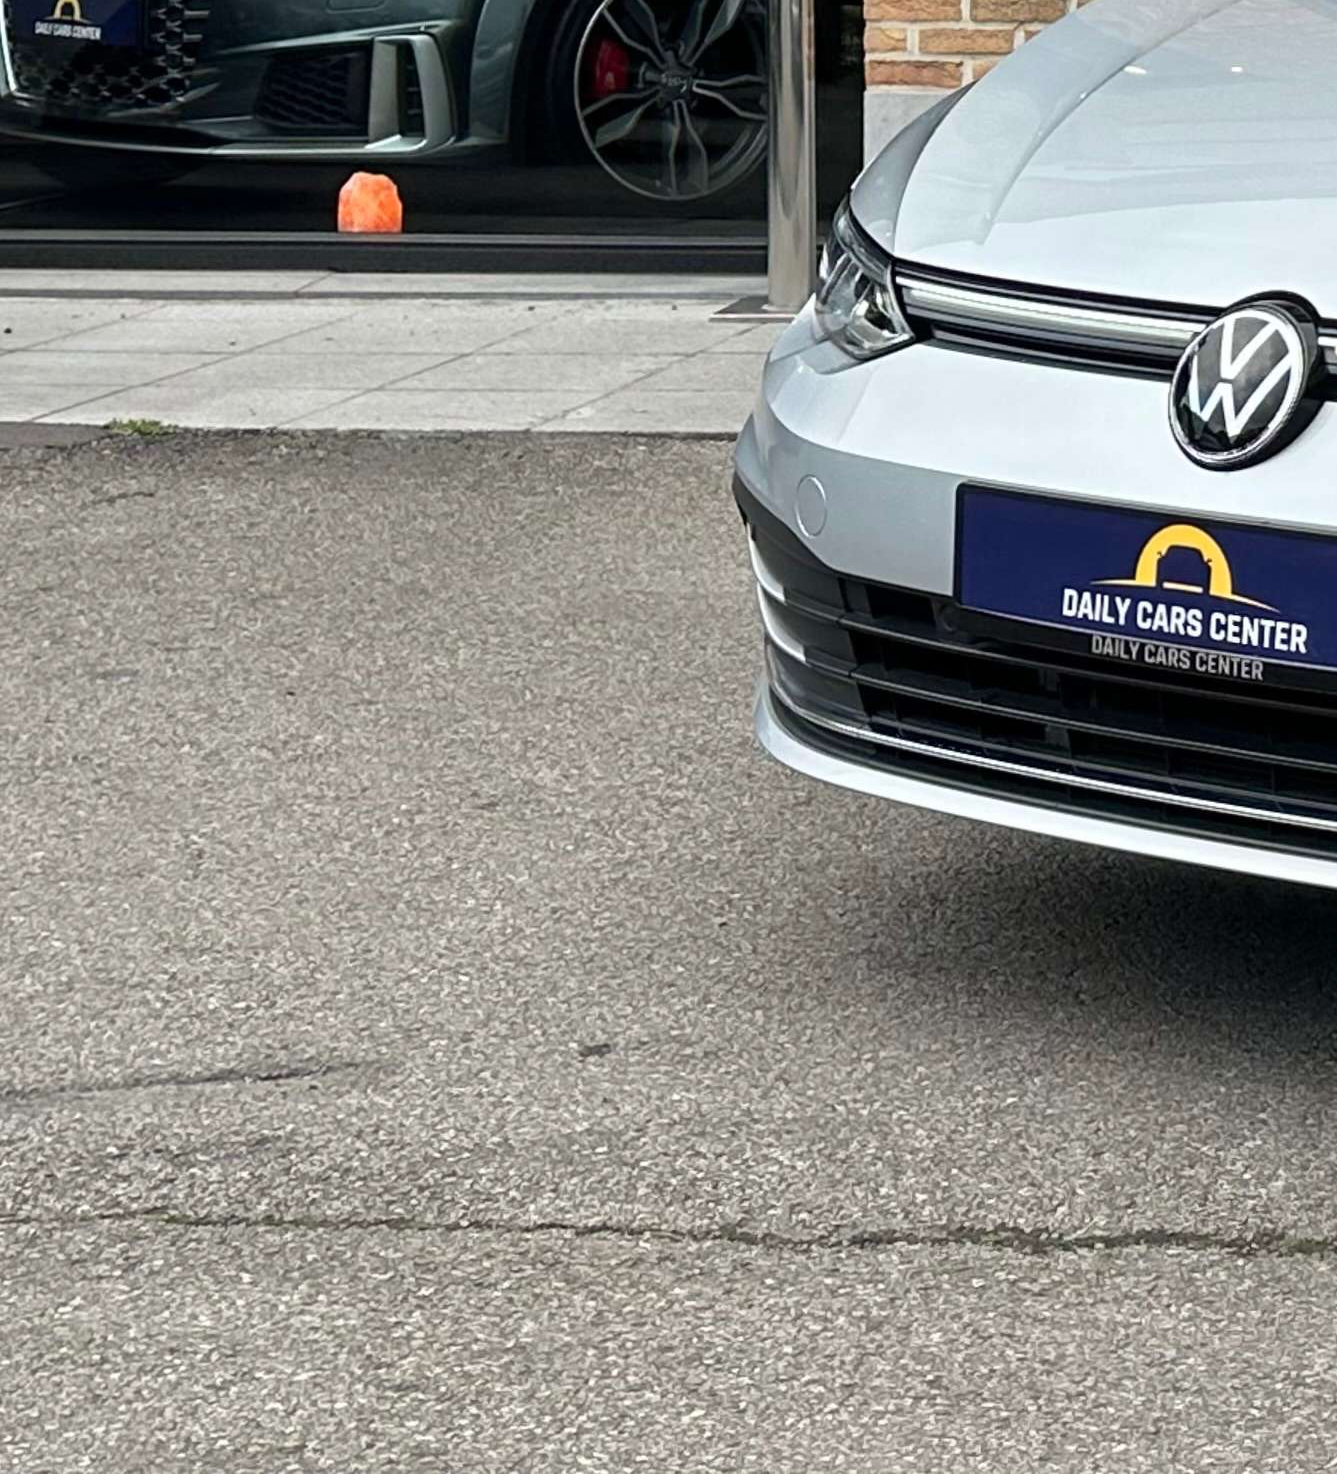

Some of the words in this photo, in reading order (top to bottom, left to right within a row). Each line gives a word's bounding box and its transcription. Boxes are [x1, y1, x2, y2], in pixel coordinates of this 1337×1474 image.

[1061, 587, 1132, 626] DAILY
[1136, 600, 1204, 638] CARS
[1209, 611, 1309, 655] CENTER
[1091, 634, 1141, 661] DAILY
[1143, 643, 1191, 670] CARS
[1195, 652, 1264, 681] CENTER
